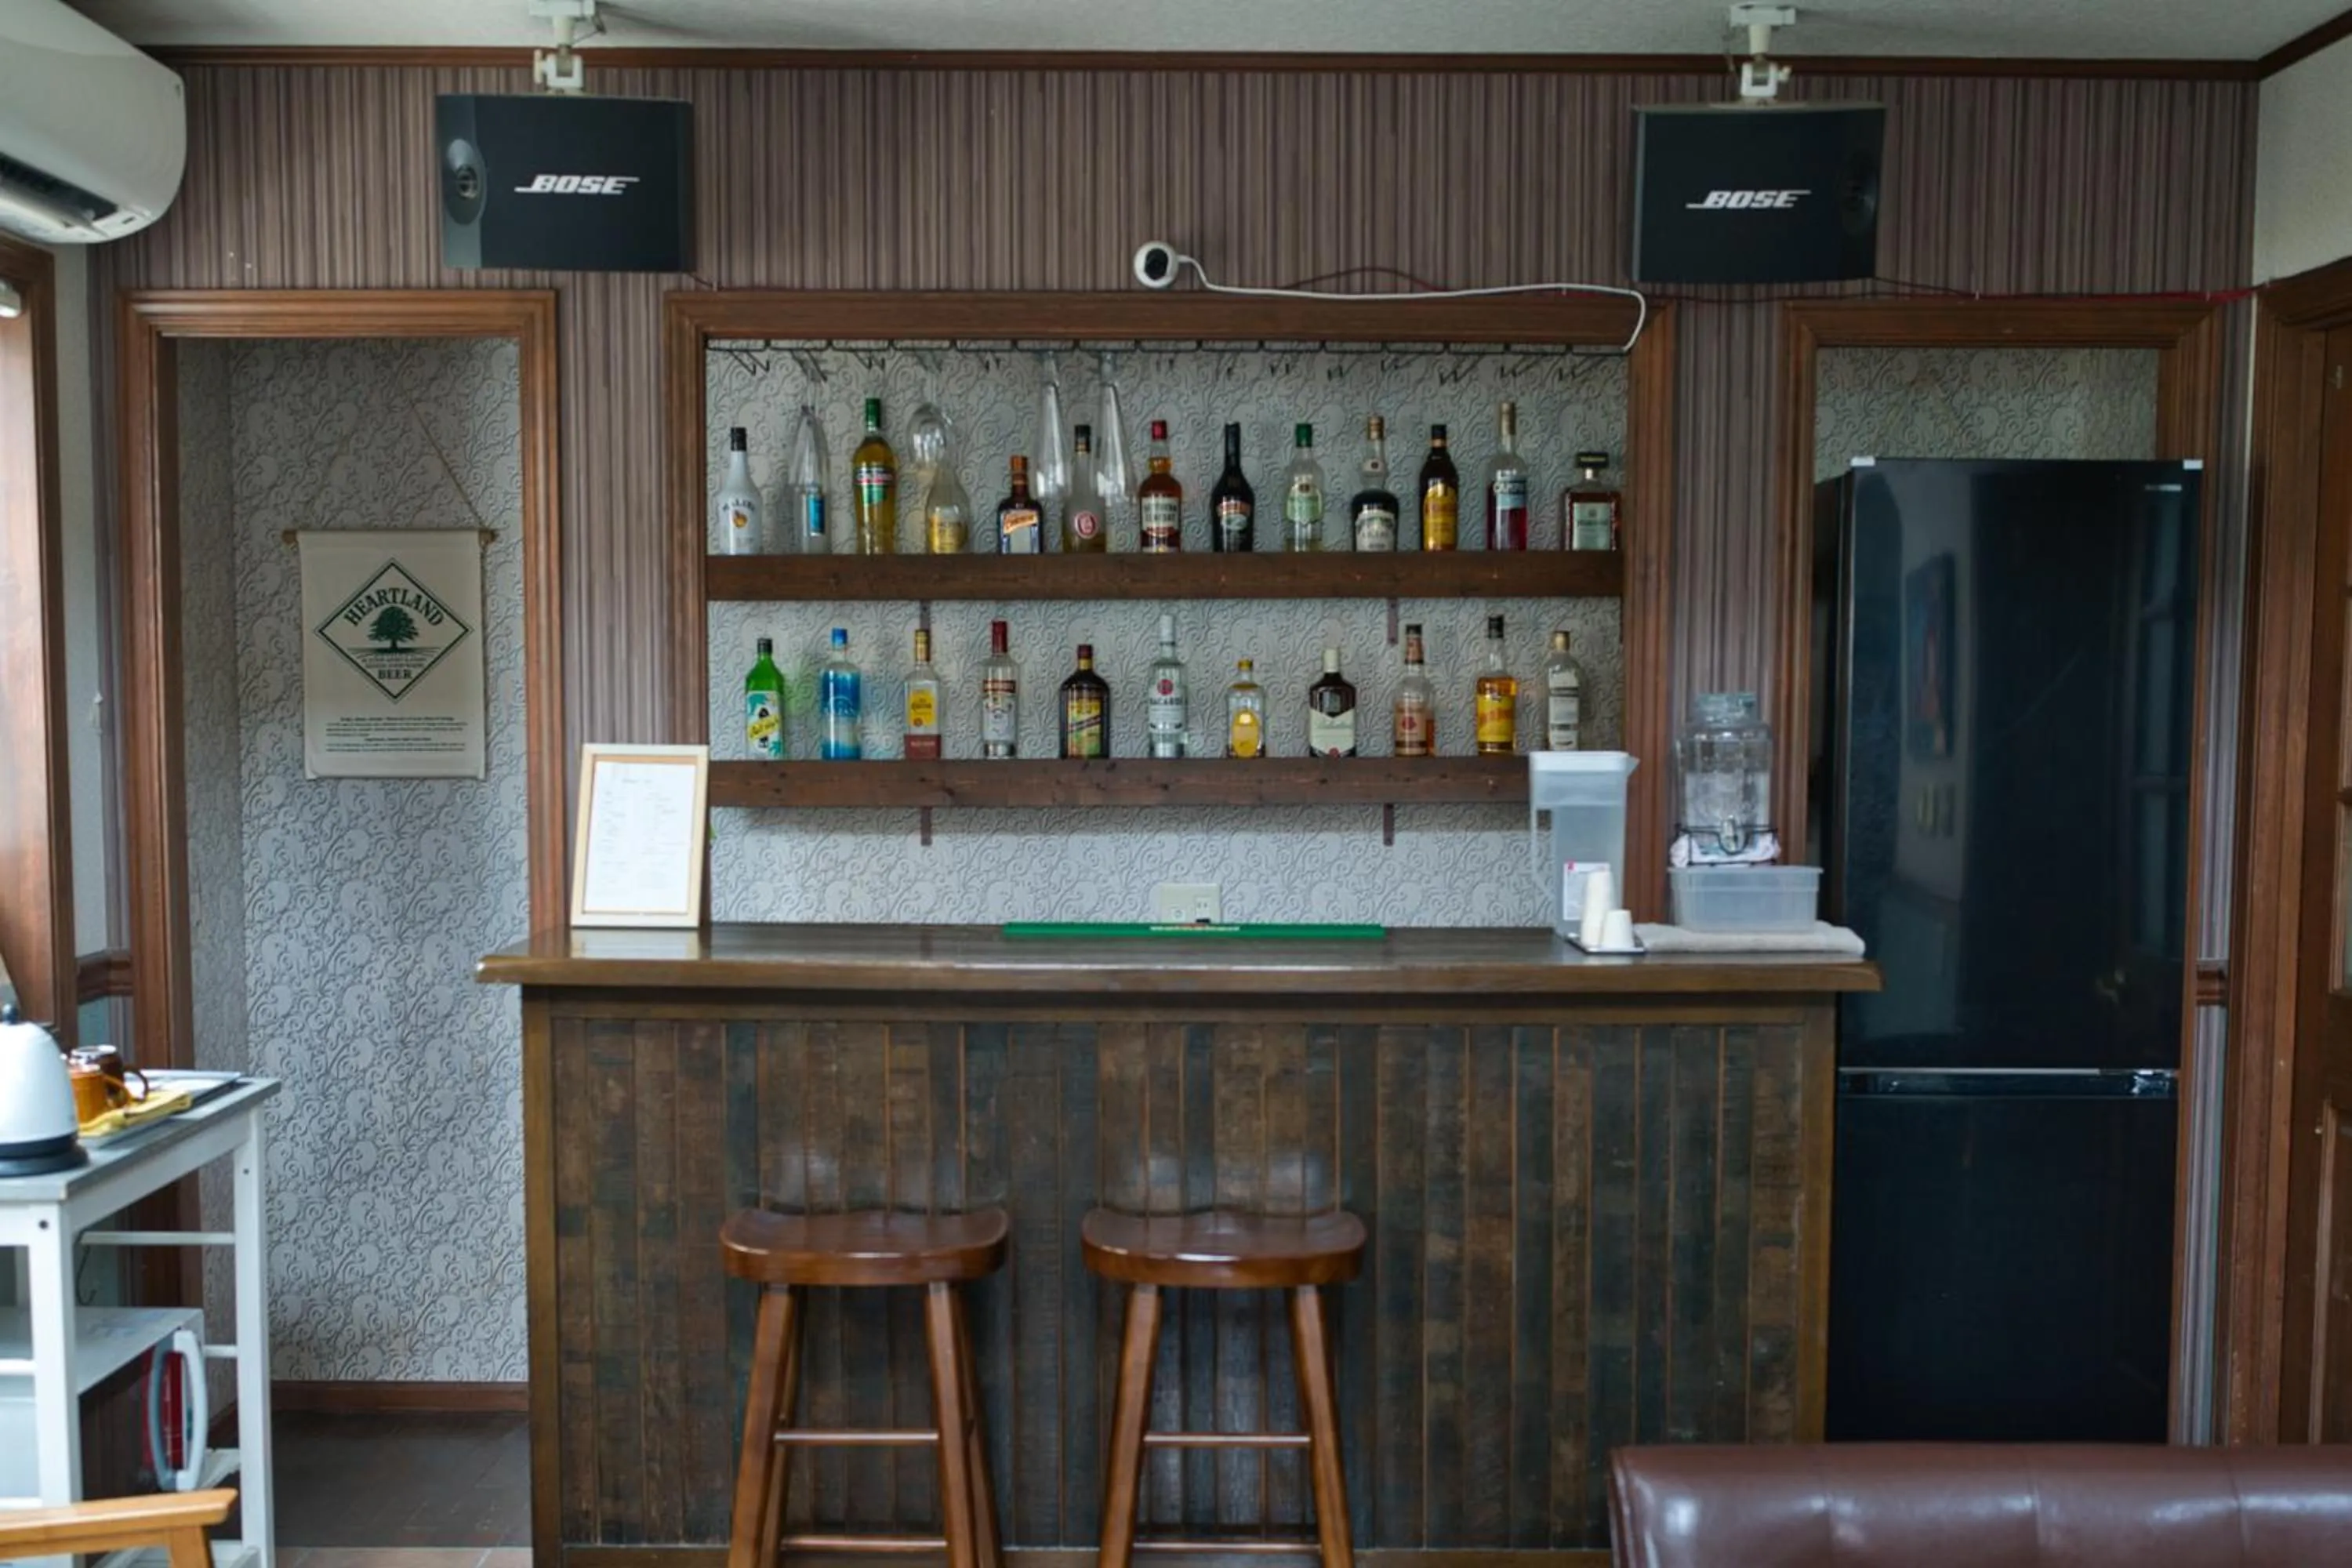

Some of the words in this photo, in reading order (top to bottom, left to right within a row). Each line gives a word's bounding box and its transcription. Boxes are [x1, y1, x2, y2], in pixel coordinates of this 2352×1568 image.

[514, 174, 640, 194] BOSE
[1686, 190, 1811, 209] BOSE
[343, 587, 444, 627] HEARTLAND
[378, 669, 412, 680] BEER
